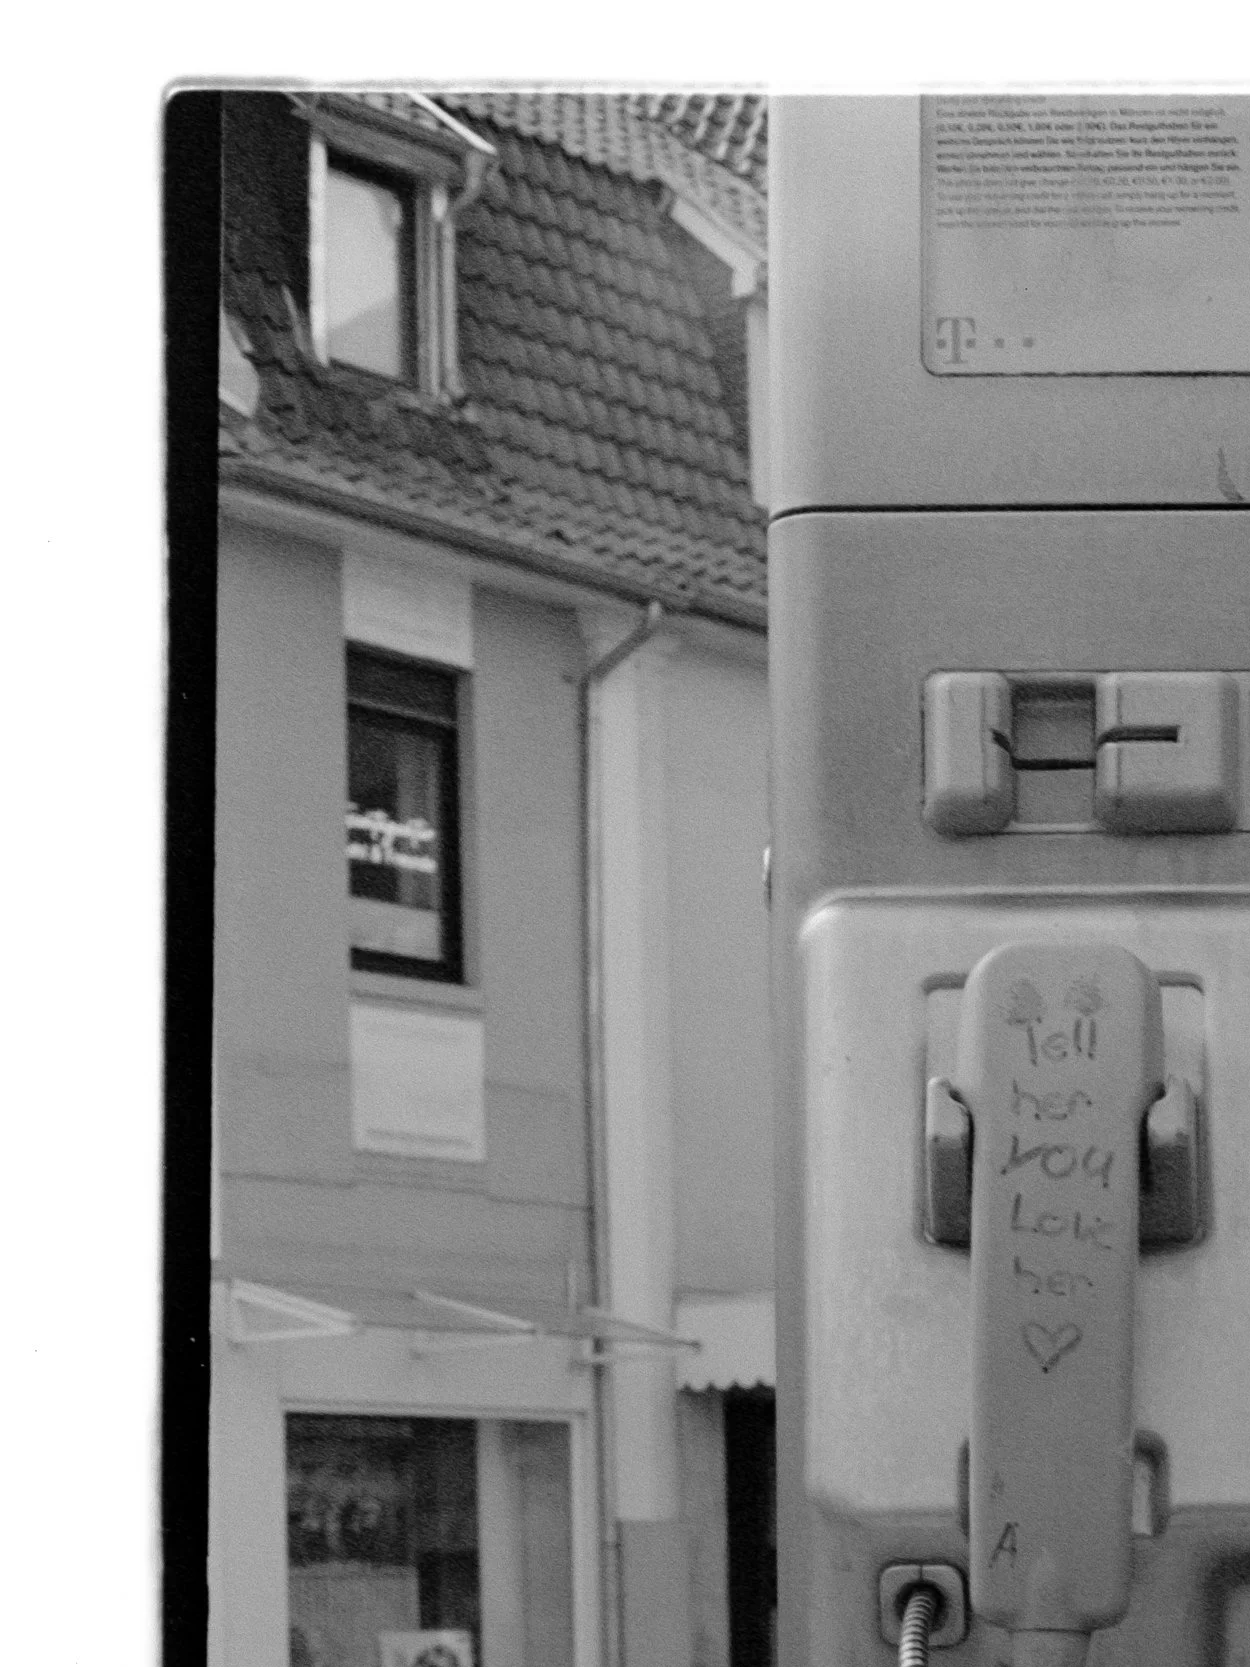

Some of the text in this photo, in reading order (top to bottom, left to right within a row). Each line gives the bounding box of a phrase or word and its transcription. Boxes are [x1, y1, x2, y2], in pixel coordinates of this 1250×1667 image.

[1005, 1015, 1099, 1067] Tell
[1010, 1079, 1093, 1122] her
[1013, 1255, 1095, 1297] her
[988, 1521, 1021, 1569] A
